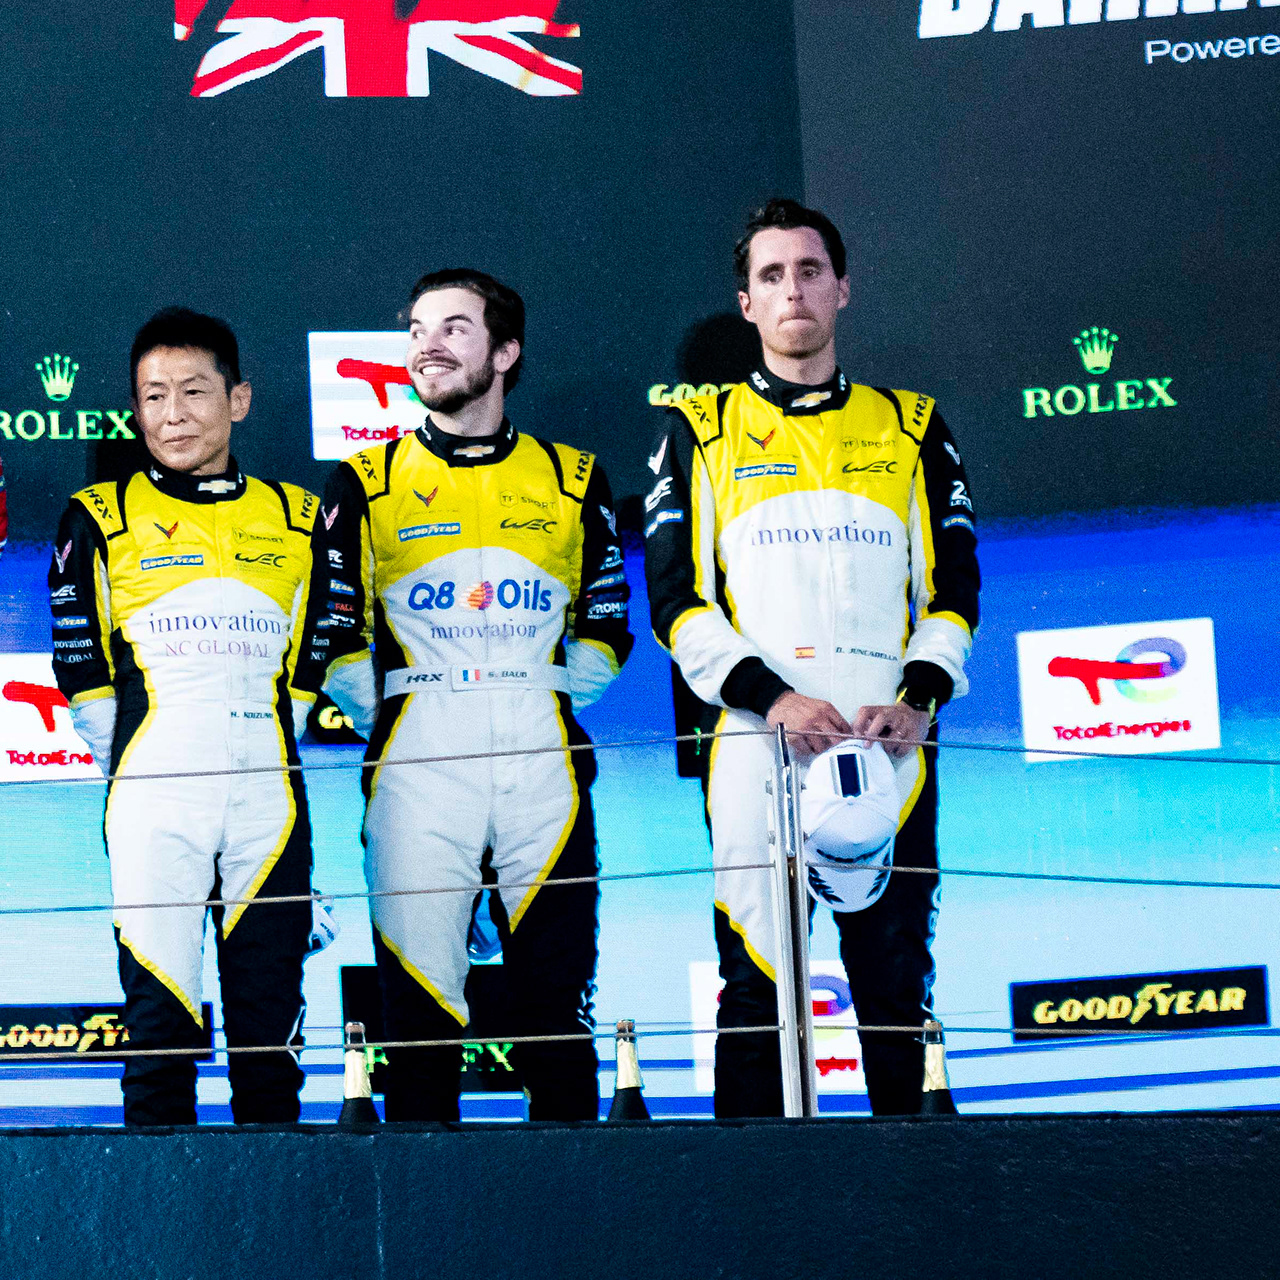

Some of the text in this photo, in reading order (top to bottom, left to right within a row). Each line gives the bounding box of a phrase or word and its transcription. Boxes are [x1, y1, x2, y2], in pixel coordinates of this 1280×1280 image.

[1022, 376, 1178, 419] ROLEX
[736, 464, 796, 478] GOODYEAR
[842, 460, 898, 474] WEC
[521, 496, 556, 510] SPORT
[400, 524, 459, 539] GOODYEAR
[500, 518, 558, 534] WEC
[749, 519, 892, 548] innovation
[142, 556, 203, 569] GOODYEAR
[235, 552, 287, 567] WEC
[407, 581, 454, 611] Q8
[497, 578, 552, 612] Oils
[149, 609, 281, 634] innovation
[165, 639, 271, 658] NC GLOBAL
[406, 673, 444, 684] HRX
[1053, 718, 1192, 742] TotalEnergies
[1033, 983, 1247, 1024] GOODYEAR
